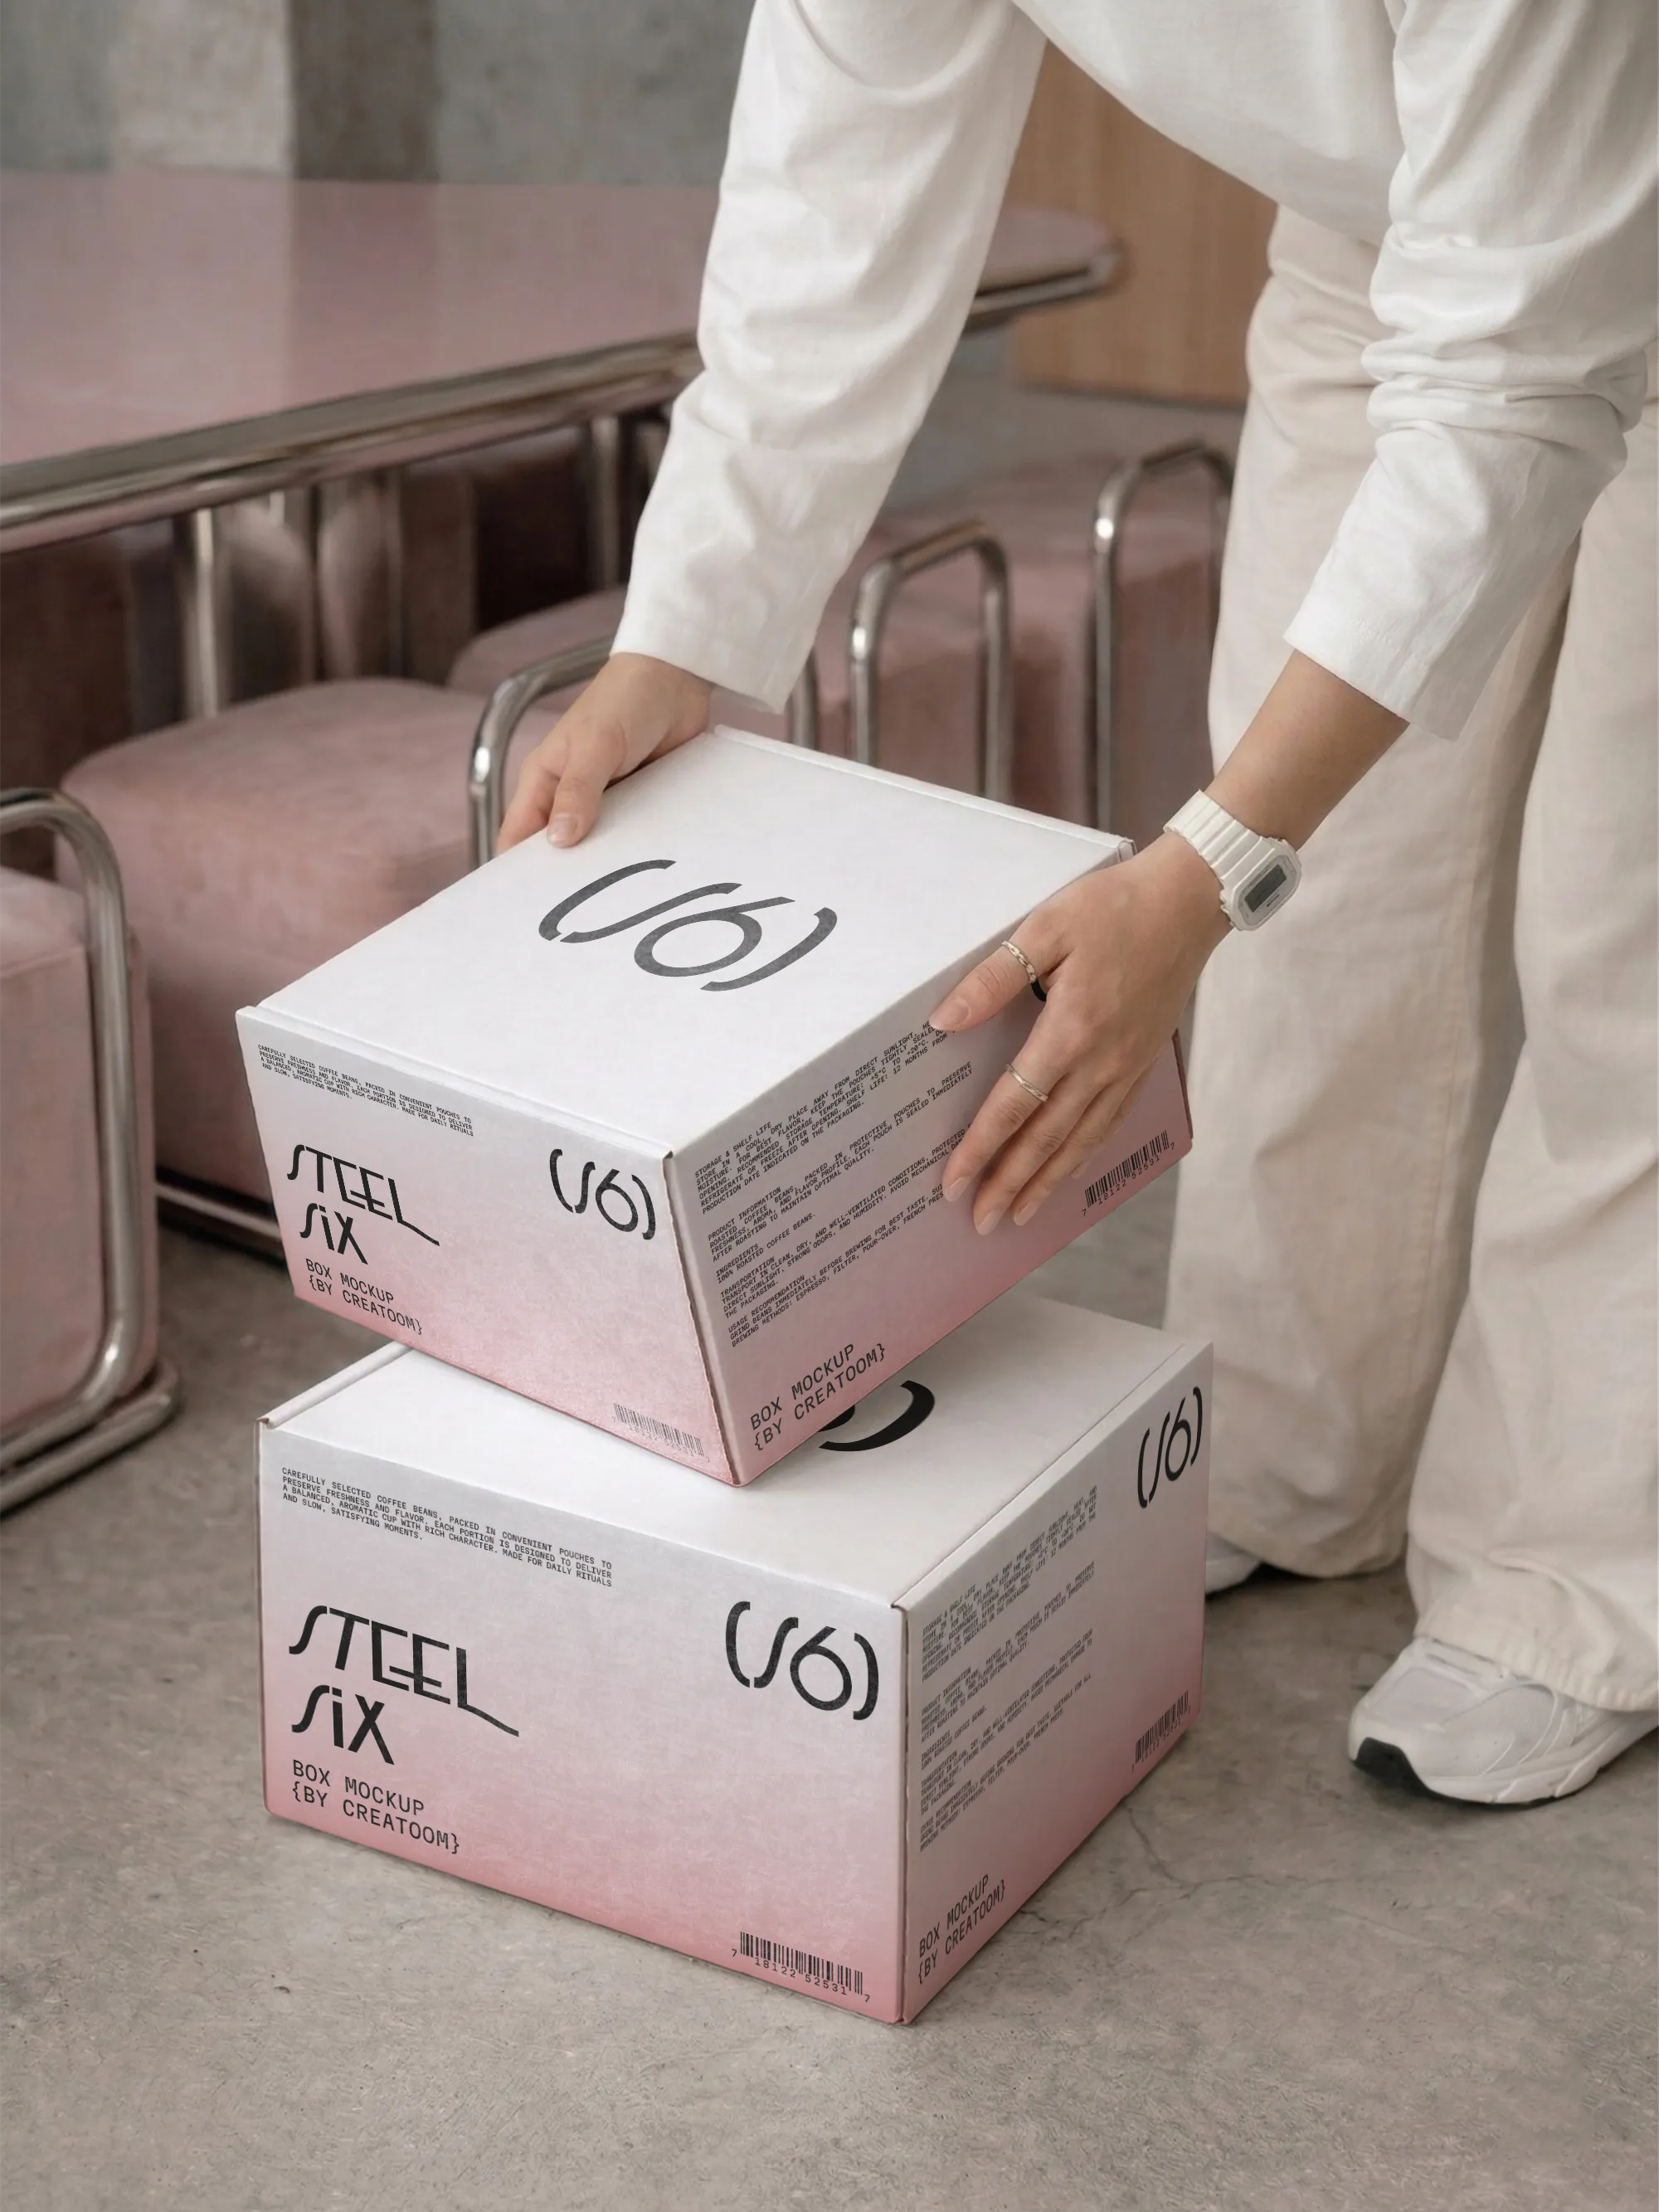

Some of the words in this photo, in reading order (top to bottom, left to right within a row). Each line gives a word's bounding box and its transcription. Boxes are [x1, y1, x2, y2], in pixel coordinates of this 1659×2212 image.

[695, 1155, 722, 1177] STORAGE
[732, 1134, 752, 1152] SHELF
[756, 1121, 771, 1136] LIFE
[709, 1225, 737, 1248] ROASTED
[744, 1204, 767, 1224] COFFEE
[805, 1162, 827, 1182] PACKED
[834, 1152, 842, 1161] IN
[849, 1120, 887, 1150] PROTECTIVE
[893, 1098, 920, 1119] POUCHES
[927, 1087, 935, 1096] TO
[941, 1061, 971, 1086] PRESERVE
[1098, 1179, 1126, 1205] 18122
[1132, 1155, 1160, 1179] 52531
[708, 1218, 734, 1240] PRODUCT
[738, 1186, 781, 1220] INFORMATION
[713, 1245, 732, 1262] AFTER
[735, 1220, 766, 1246] ROASTING
[769, 1213, 777, 1221] TO
[781, 1189, 811, 1214] MAINTAIN
[815, 1169, 841, 1191] OPTIMAL
[306, 1259, 332, 1279] BOX
[340, 1273, 393, 1303] MOCKUP
[716, 1243, 758, 1277] INGREDIENTS
[718, 1269, 733, 1284] 100%
[736, 1247, 763, 1270] ROASTED
[766, 1228, 790, 1249] COFFEE
[720, 1256, 774, 1298] TRANSPORTATION
[730, 1323, 749, 1339] GRIND
[752, 1306, 771, 1323] BEANS
[775, 1274, 815, 1308] IMMEDIATELY
[819, 1255, 842, 1275] BEFORE
[845, 1235, 871, 1258] BREWING
[874, 1225, 886, 1235] FOR
[888, 1211, 903, 1226] BEST
[732, 1324, 759, 1347] BREWING
[903, 1204, 925, 1224] FRENCH
[725, 1307, 737, 1318] THE
[728, 1315, 747, 1333] USAGE
[751, 1274, 805, 1317] RECOMMENDATION
[751, 1397, 782, 1430] BOX
[791, 1345, 854, 1400] MOCKUP
[282, 1467, 325, 1485] CAREFULLY
[332, 1481, 371, 1498] SELECTED
[377, 1495, 406, 1509] COFFEE
[450, 1516, 479, 1530] PACKED
[485, 1526, 495, 1535] IN
[502, 1531, 552, 1552] CONVENIENT
[559, 1547, 594, 1564] POUCHES
[601, 1560, 611, 1569] TO
[283, 1493, 297, 1503] AND
[331, 1507, 379, 1527] SATISFYING
[283, 1476, 320, 1493] PRESERVE
[326, 1488, 369, 1507] FRESHNESS
[375, 1503, 389, 1513] AND
[435, 1520, 454, 1532] EACH
[460, 1527, 494, 1543] PORTION
[499, 1539, 509, 1548] IS
[514, 1543, 555, 1562] DESIGNED
[561, 1557, 571, 1566] TO
[576, 1562, 611, 1578] DELIVER
[339, 1500, 377, 1518] AROMATIC
[382, 1513, 397, 1523] CUP
[401, 1518, 421, 1530] WITH
[425, 1525, 445, 1537] RICH
[503, 1548, 523, 1561] MADE
[528, 1556, 542, 1566] FOR
[546, 1562, 572, 1574] DAILY
[576, 1570, 611, 1586] RITUALS
[294, 1760, 330, 1786] BOX
[345, 1776, 423, 1815] MOCKUP
[293, 1781, 328, 1807] {BY
[343, 1800, 459, 1854] CREATOOM}
[920, 1922, 940, 1957] BOX
[947, 1873, 989, 1926] MOCKUP
[732, 1948, 737, 1957] 7
[755, 1958, 795, 1978] 18122
[805, 1975, 847, 1995] 52531
[864, 1994, 870, 2003] 7
